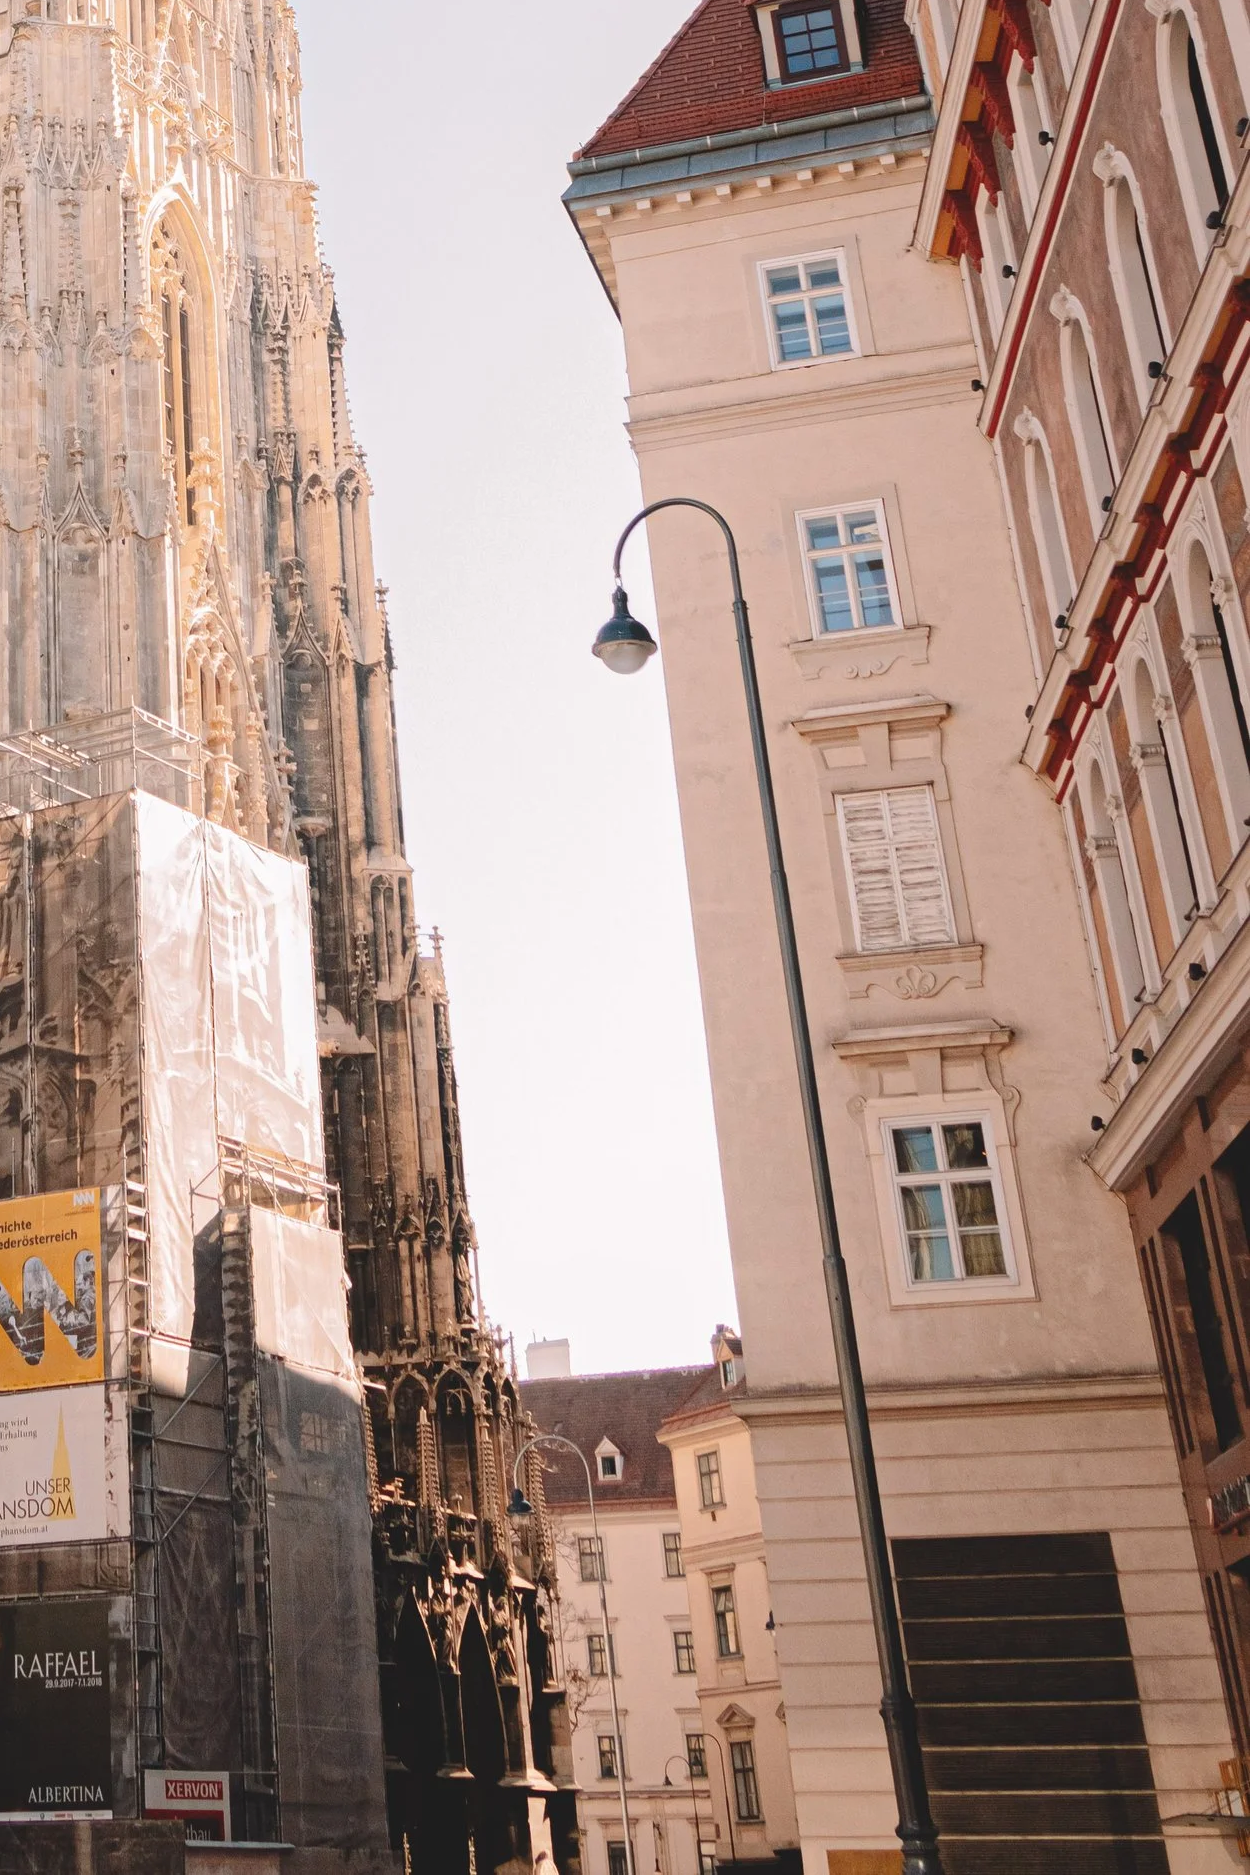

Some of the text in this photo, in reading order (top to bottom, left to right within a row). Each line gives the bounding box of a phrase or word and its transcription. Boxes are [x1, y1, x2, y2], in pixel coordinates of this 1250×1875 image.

[10, 1417, 28, 1427] wird
[0, 1429, 38, 1441] Erhaltung
[25, 1477, 71, 1496] UNSER
[14, 1650, 102, 1679] RAFFAEL
[28, 1786, 104, 1803] ALBERTINA
[166, 1781, 219, 1798] XERVON
